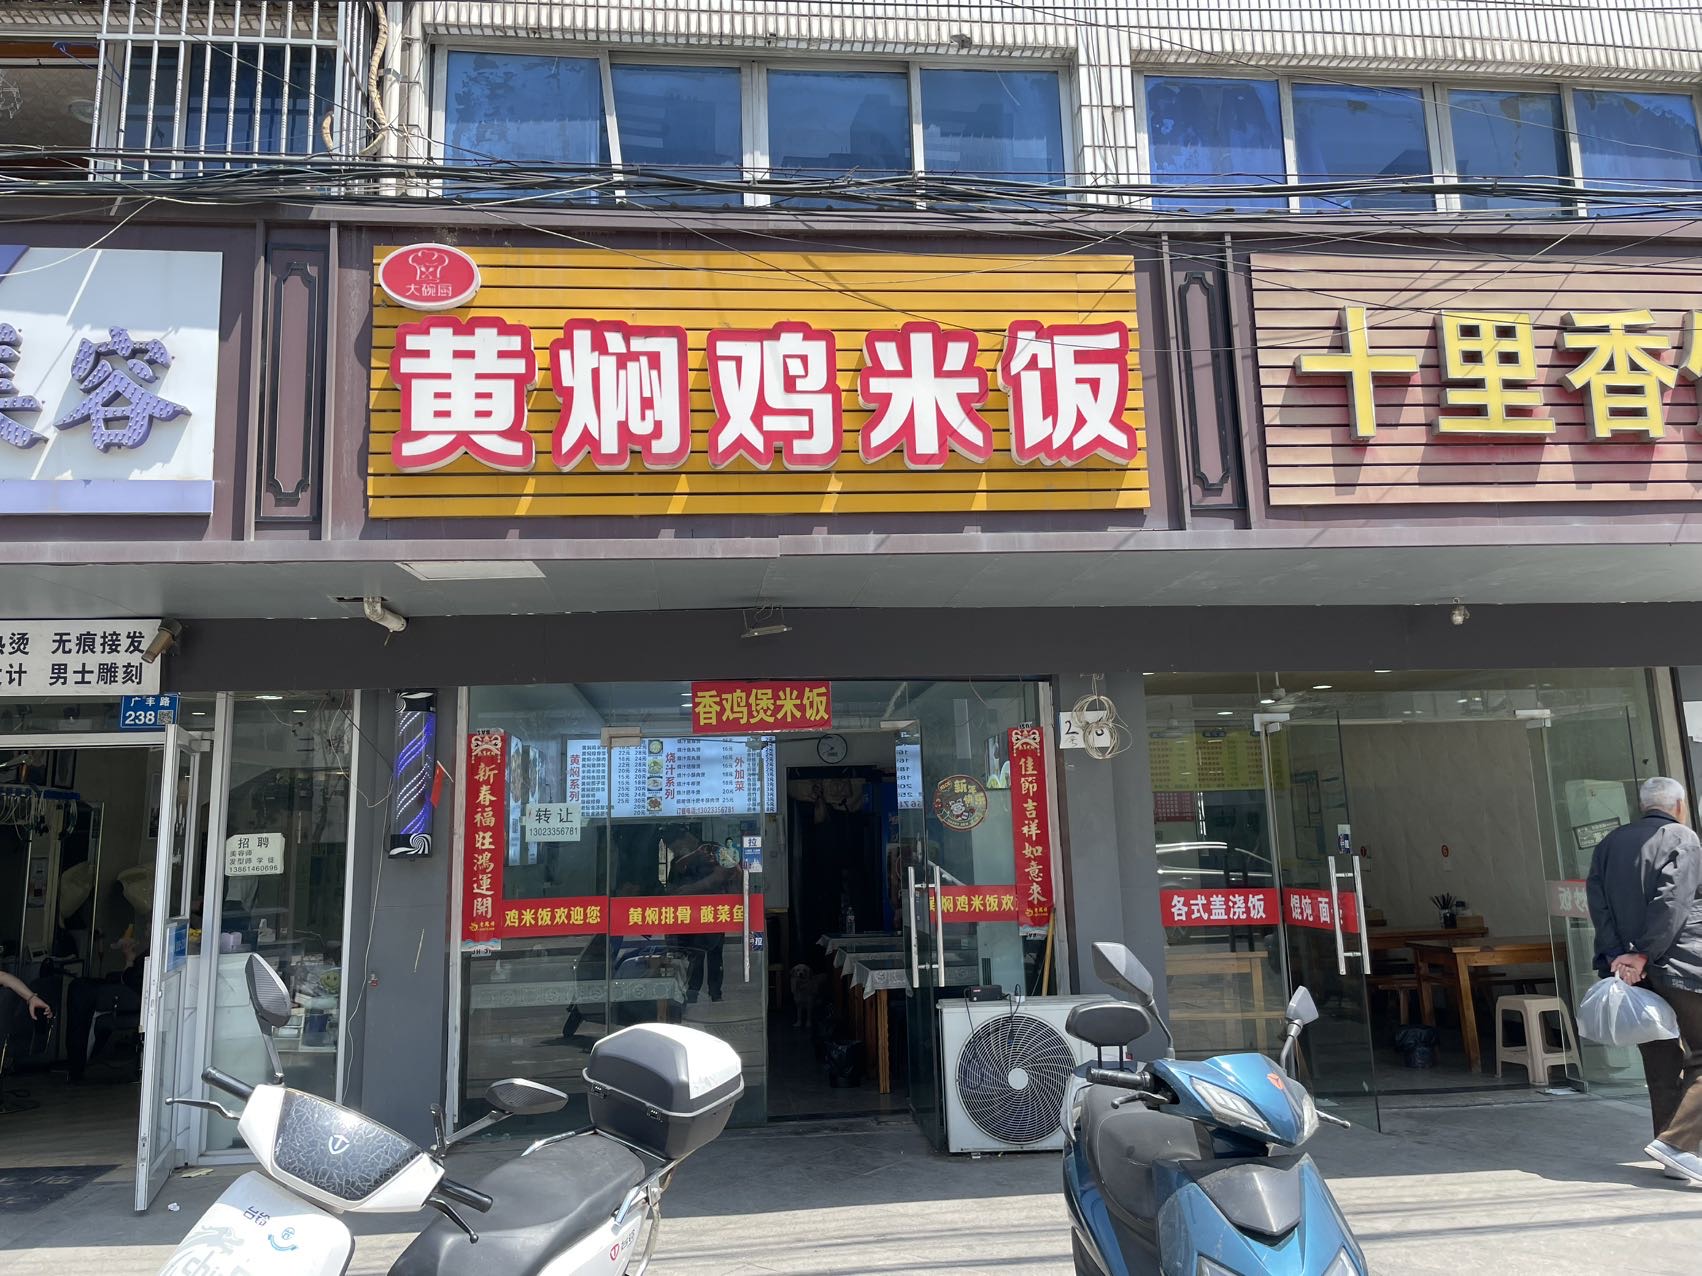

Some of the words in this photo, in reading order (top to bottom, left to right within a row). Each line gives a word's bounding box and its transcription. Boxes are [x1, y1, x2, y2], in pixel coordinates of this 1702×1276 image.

[405, 283, 452, 297] 大碗厨
[1294, 304, 1702, 442] 十里香
[394, 320, 1136, 468] 黄焖鸡米饭
[51, 631, 146, 656] 无痕接发
[0, 662, 28, 687] 计
[48, 662, 144, 687] 男士雕刻
[130, 696, 171, 707] 广丰路
[694, 686, 829, 726] 香鸡煲米饭
[124, 711, 156, 725] 238
[569, 753, 580, 802] 黄焖系列
[665, 751, 676, 800] 烧汁系列
[734, 756, 745, 792] 外加菜
[535, 808, 574, 825] 转让
[238, 836, 270, 849] 招聘
[529, 826, 580, 837] 13023356781
[748, 837, 757, 847] 拉
[504, 905, 602, 928] 鸡米饭欢迎您
[627, 904, 692, 926] 黄焖排骨
[699, 903, 745, 924] 酸菜鱼
[1171, 893, 1267, 922] 各式盖浇饭
[1290, 893, 1314, 922] 馄饨
